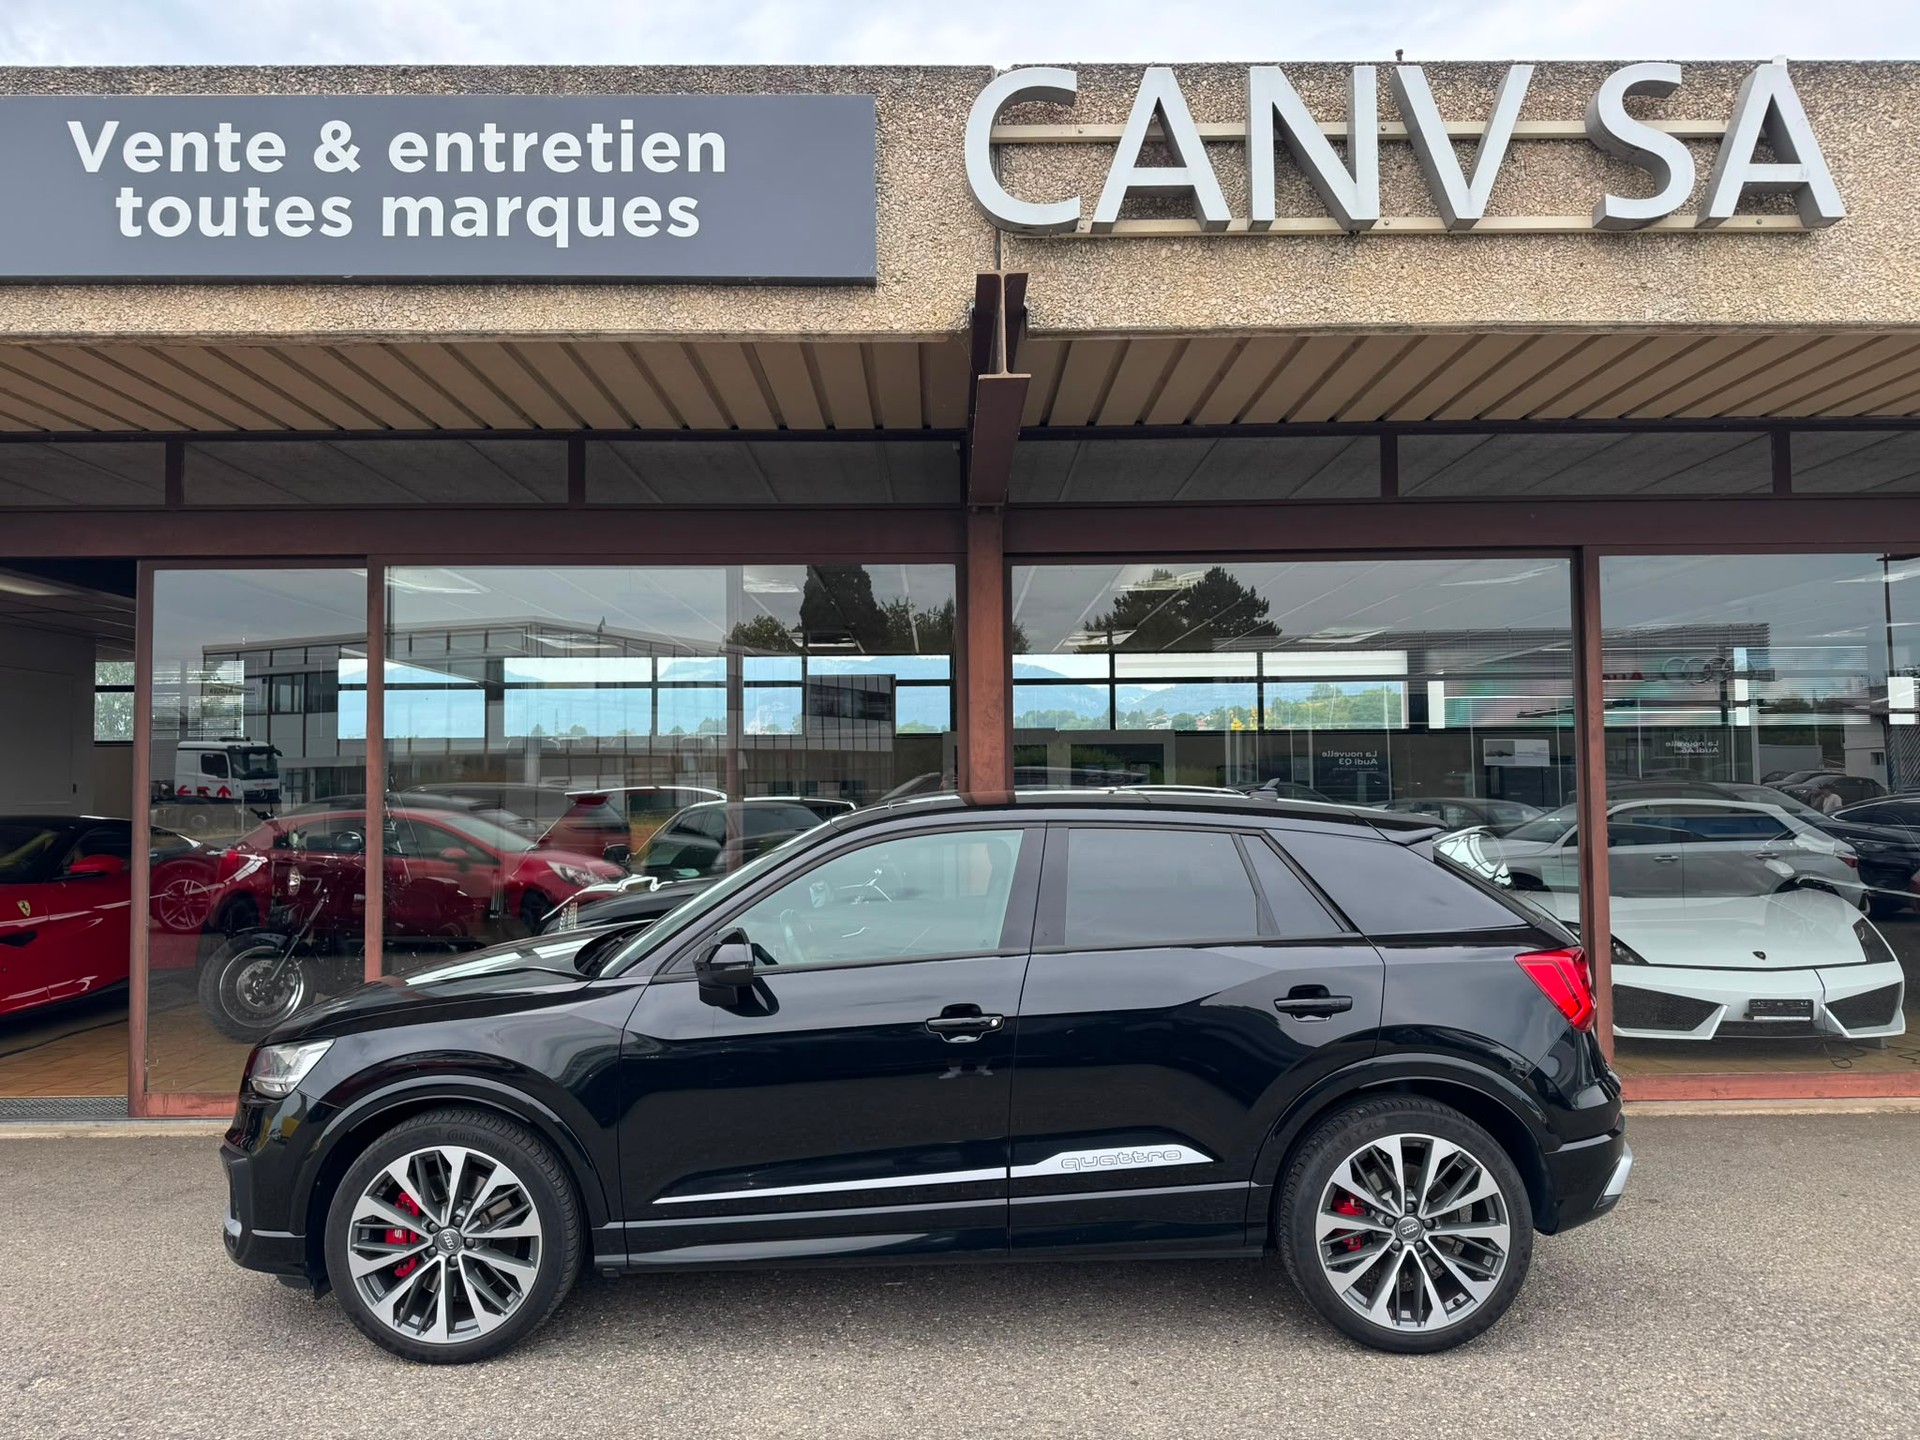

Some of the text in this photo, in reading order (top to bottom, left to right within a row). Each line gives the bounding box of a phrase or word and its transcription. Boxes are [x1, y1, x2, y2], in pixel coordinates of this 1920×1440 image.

[67, 120, 725, 172] Vente & entretien
[964, 60, 1844, 233] CANV SA
[116, 188, 699, 248] toutes marques
[1060, 1149, 1182, 1171] quattro
